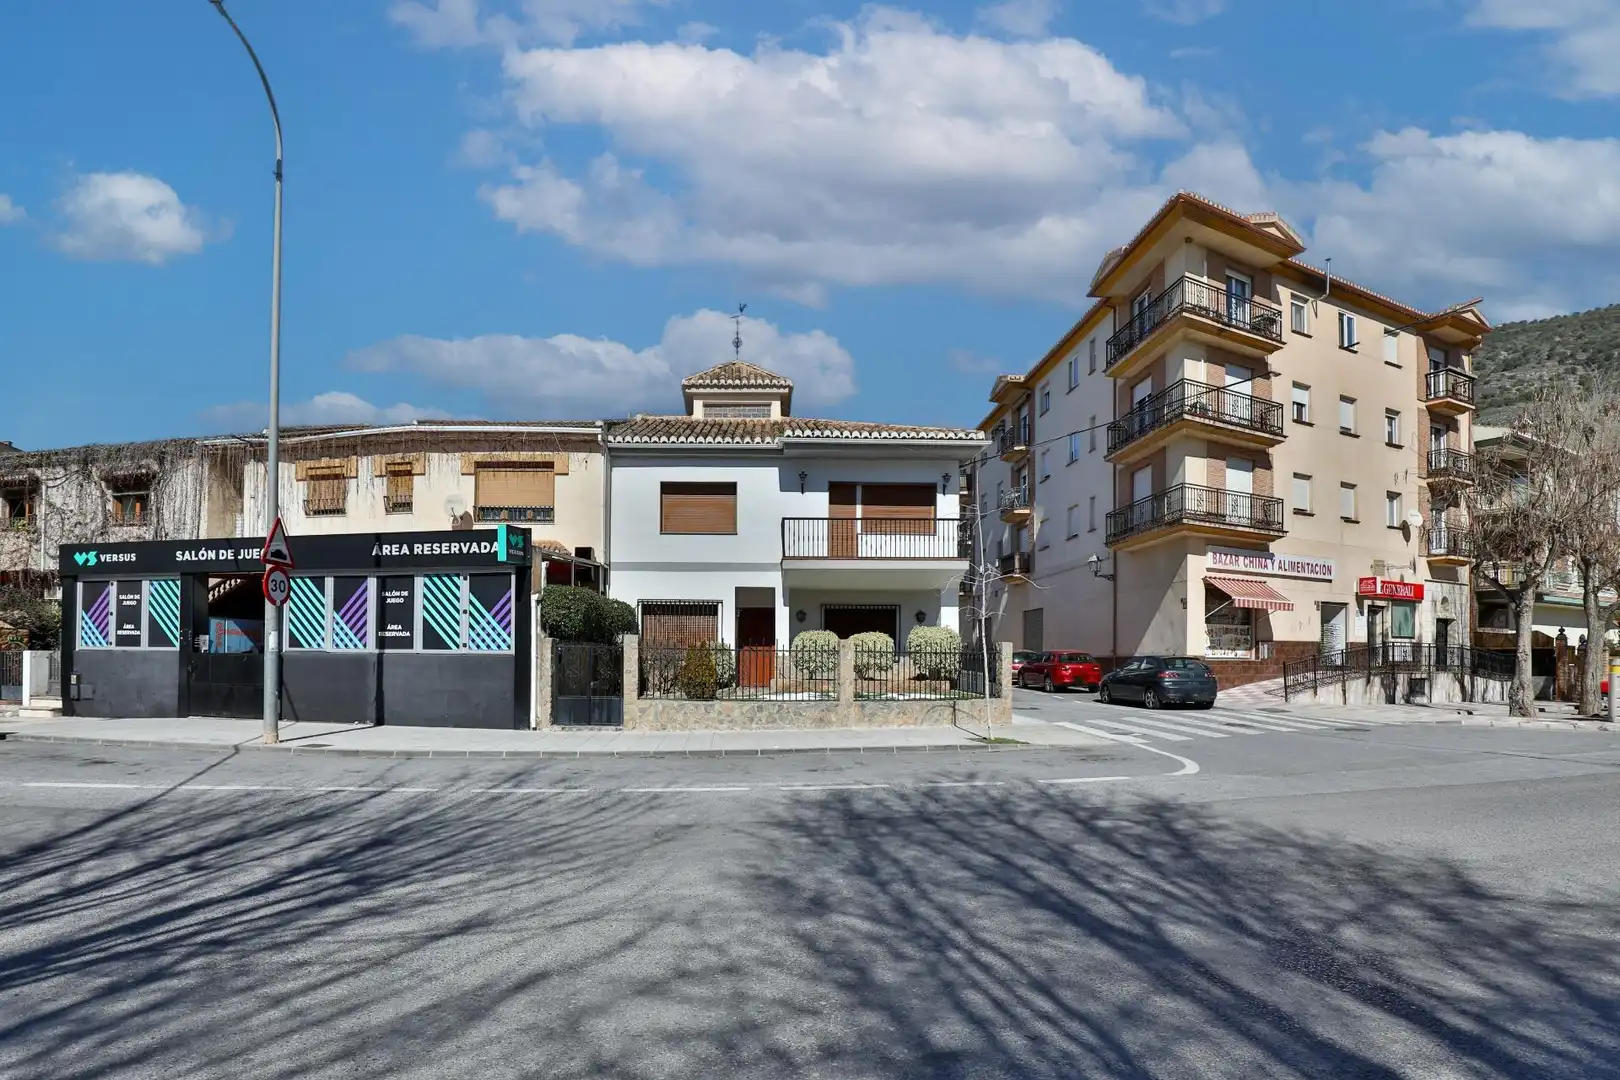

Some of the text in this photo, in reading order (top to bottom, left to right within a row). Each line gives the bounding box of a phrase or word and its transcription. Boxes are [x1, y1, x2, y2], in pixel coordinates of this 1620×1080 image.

[175, 547, 216, 561] SALÓN
[219, 549, 235, 560] DE
[371, 541, 499, 556] ÁREA RESERVADA
[100, 553, 137, 563] VERSUS
[1212, 552, 1333, 576] BAZAR CHINA Y ALIMENTACIÓN
[270, 579, 286, 593] 30
[1383, 583, 1414, 597] GENERALI
